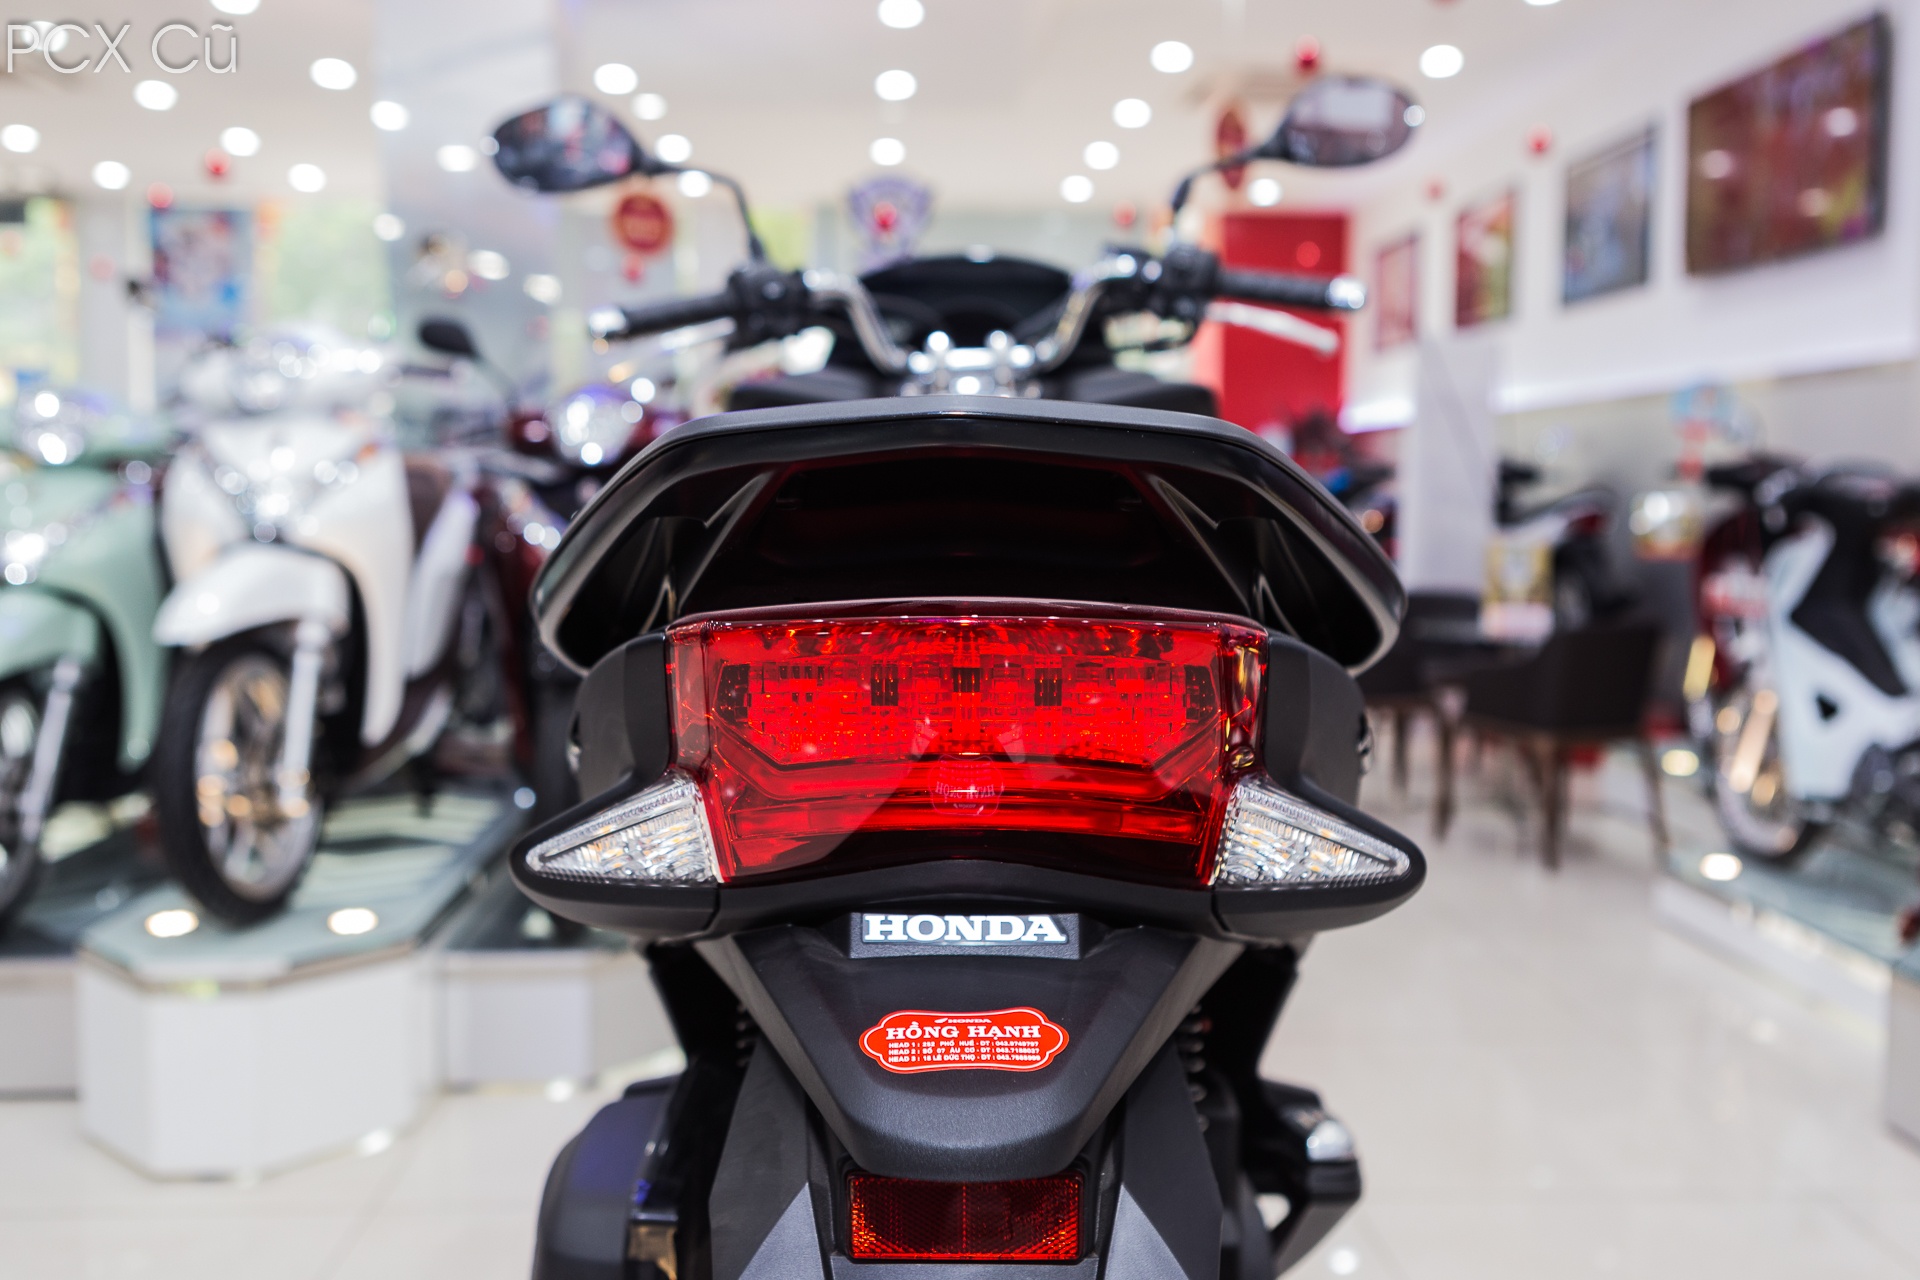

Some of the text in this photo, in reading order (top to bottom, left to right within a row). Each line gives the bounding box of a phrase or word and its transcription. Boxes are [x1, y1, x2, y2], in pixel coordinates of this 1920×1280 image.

[864, 914, 1066, 942] HONDA
[886, 1021, 1041, 1041] HỒNG HẠNH
